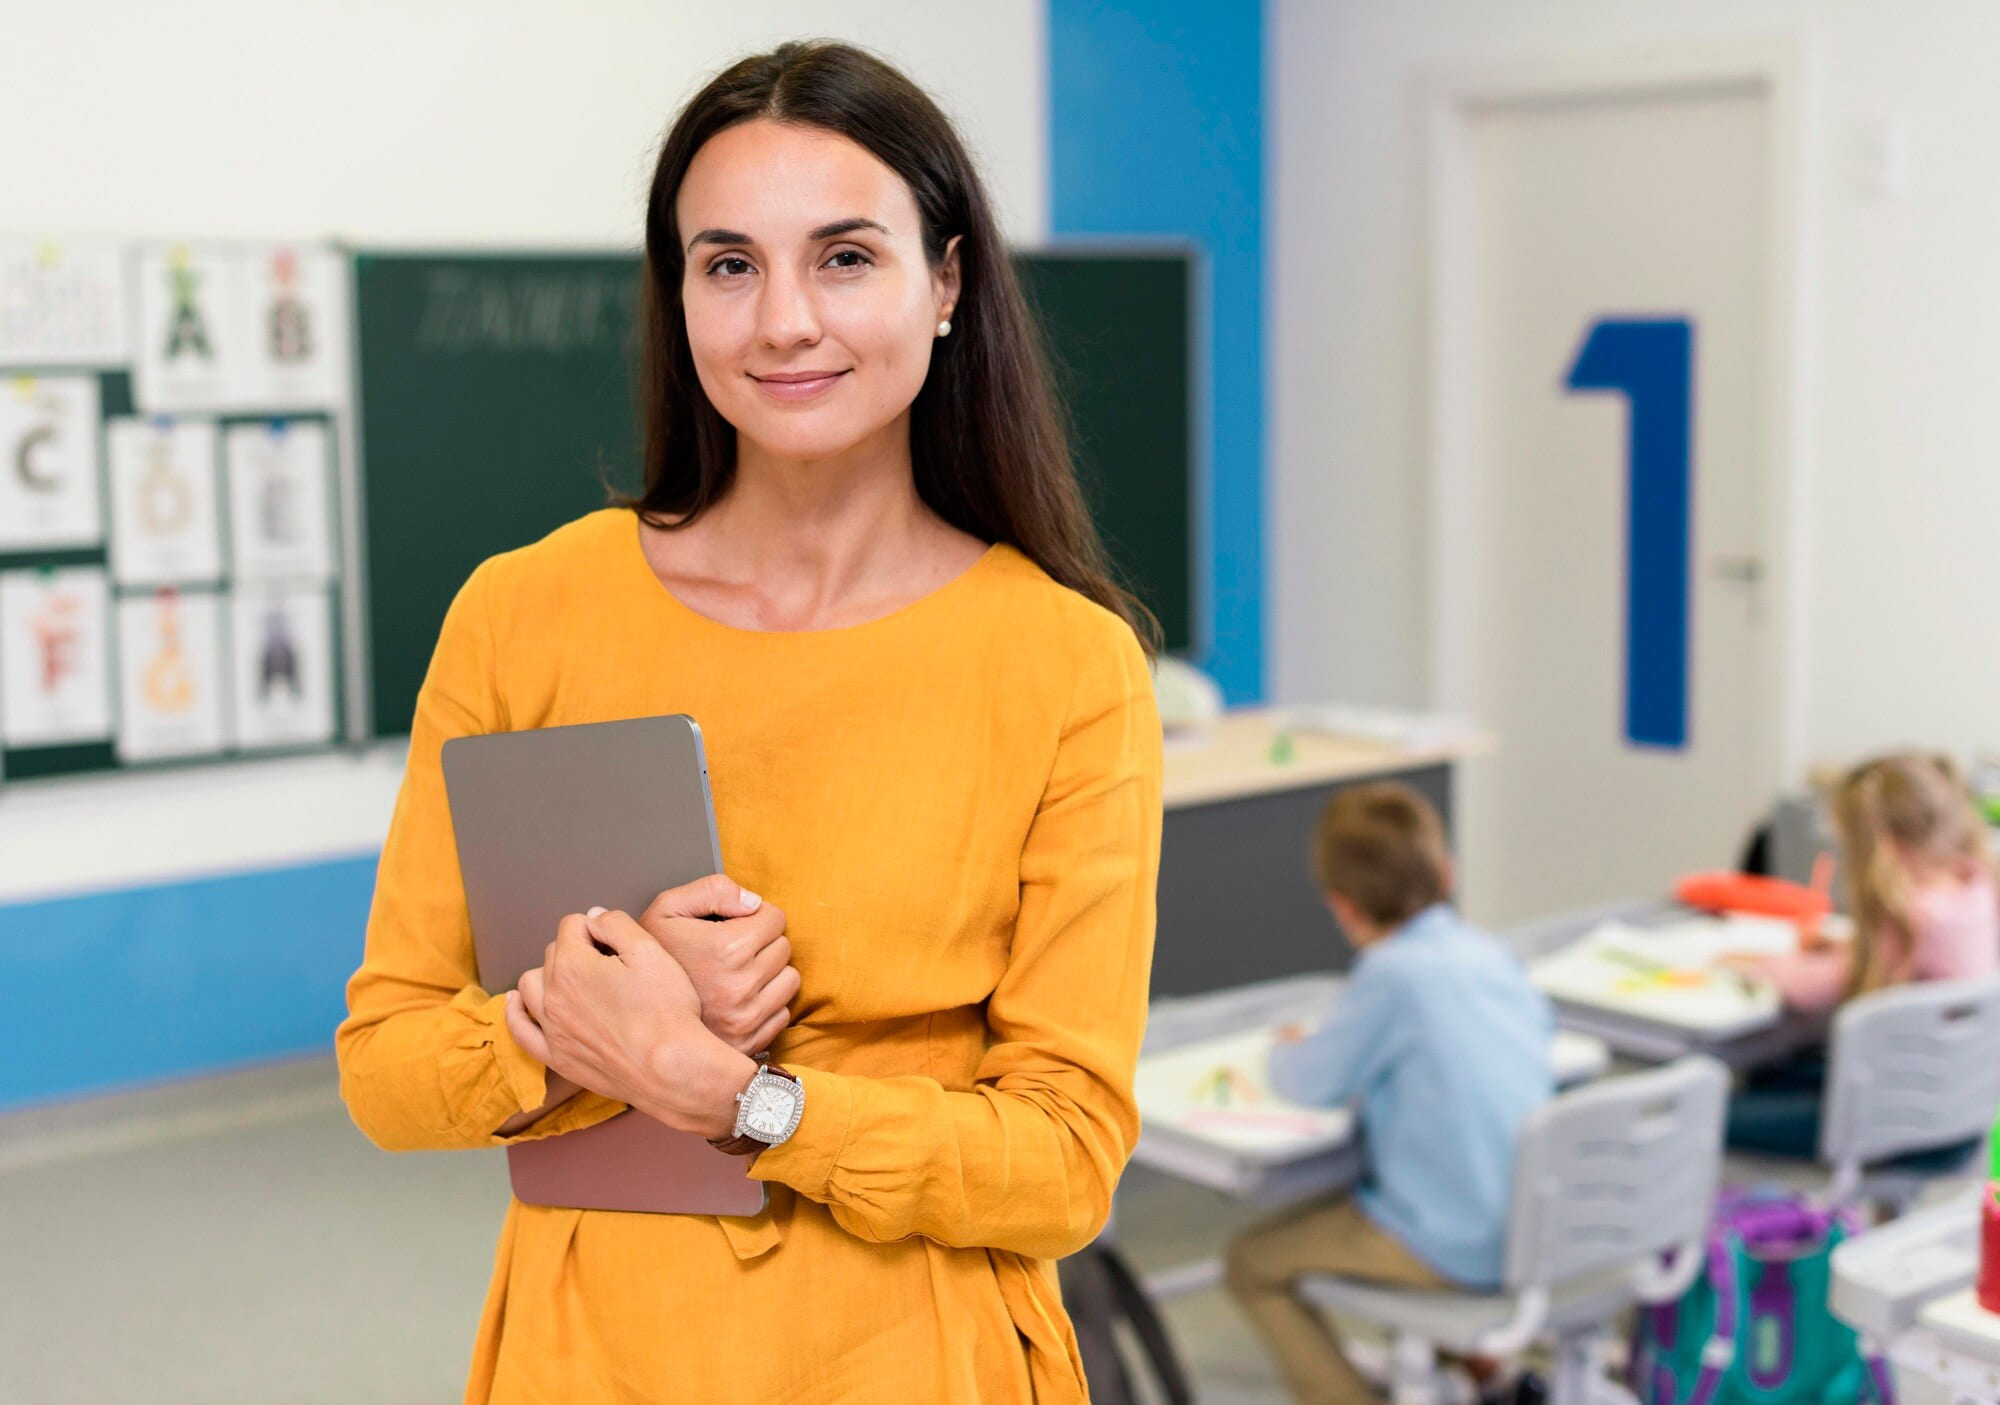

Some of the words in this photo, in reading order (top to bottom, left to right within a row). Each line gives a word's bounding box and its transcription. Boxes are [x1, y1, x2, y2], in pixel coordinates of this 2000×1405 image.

[161, 296, 216, 363] A
[14, 424, 66, 494] C
[1562, 318, 1692, 748] 1
